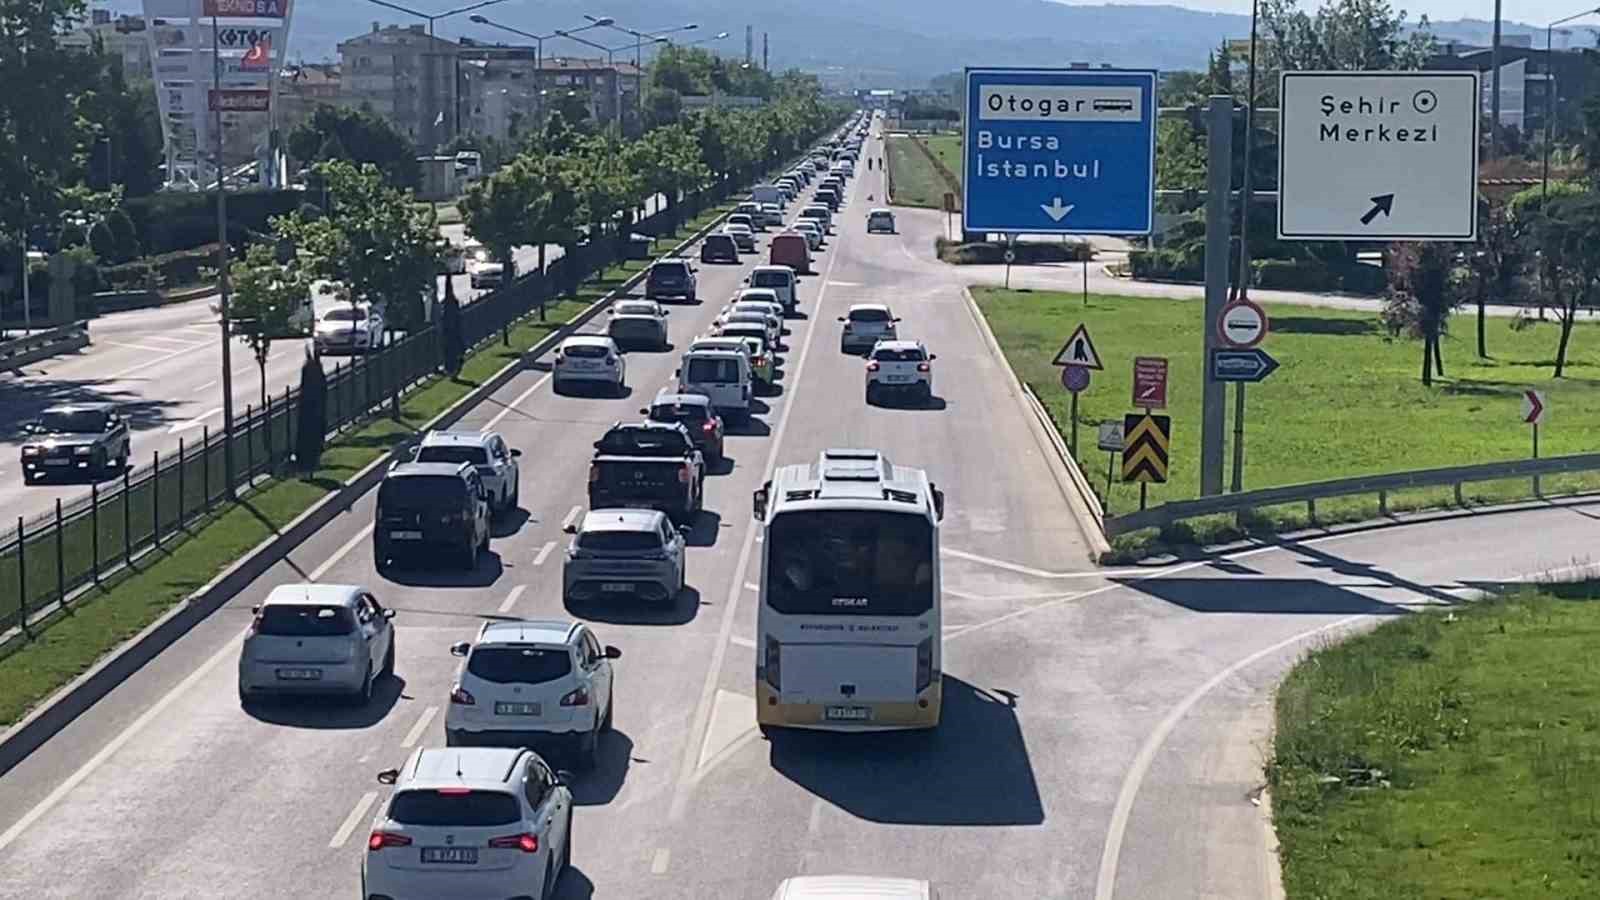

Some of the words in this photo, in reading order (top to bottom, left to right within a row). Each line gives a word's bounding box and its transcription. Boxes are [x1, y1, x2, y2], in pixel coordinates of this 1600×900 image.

[988, 94, 1086, 117] Otogar
[1320, 95, 1401, 117] Şehir
[978, 130, 1060, 150] Bursa
[1320, 123, 1438, 142] Merkezi
[977, 153, 1099, 178] İstanbul
